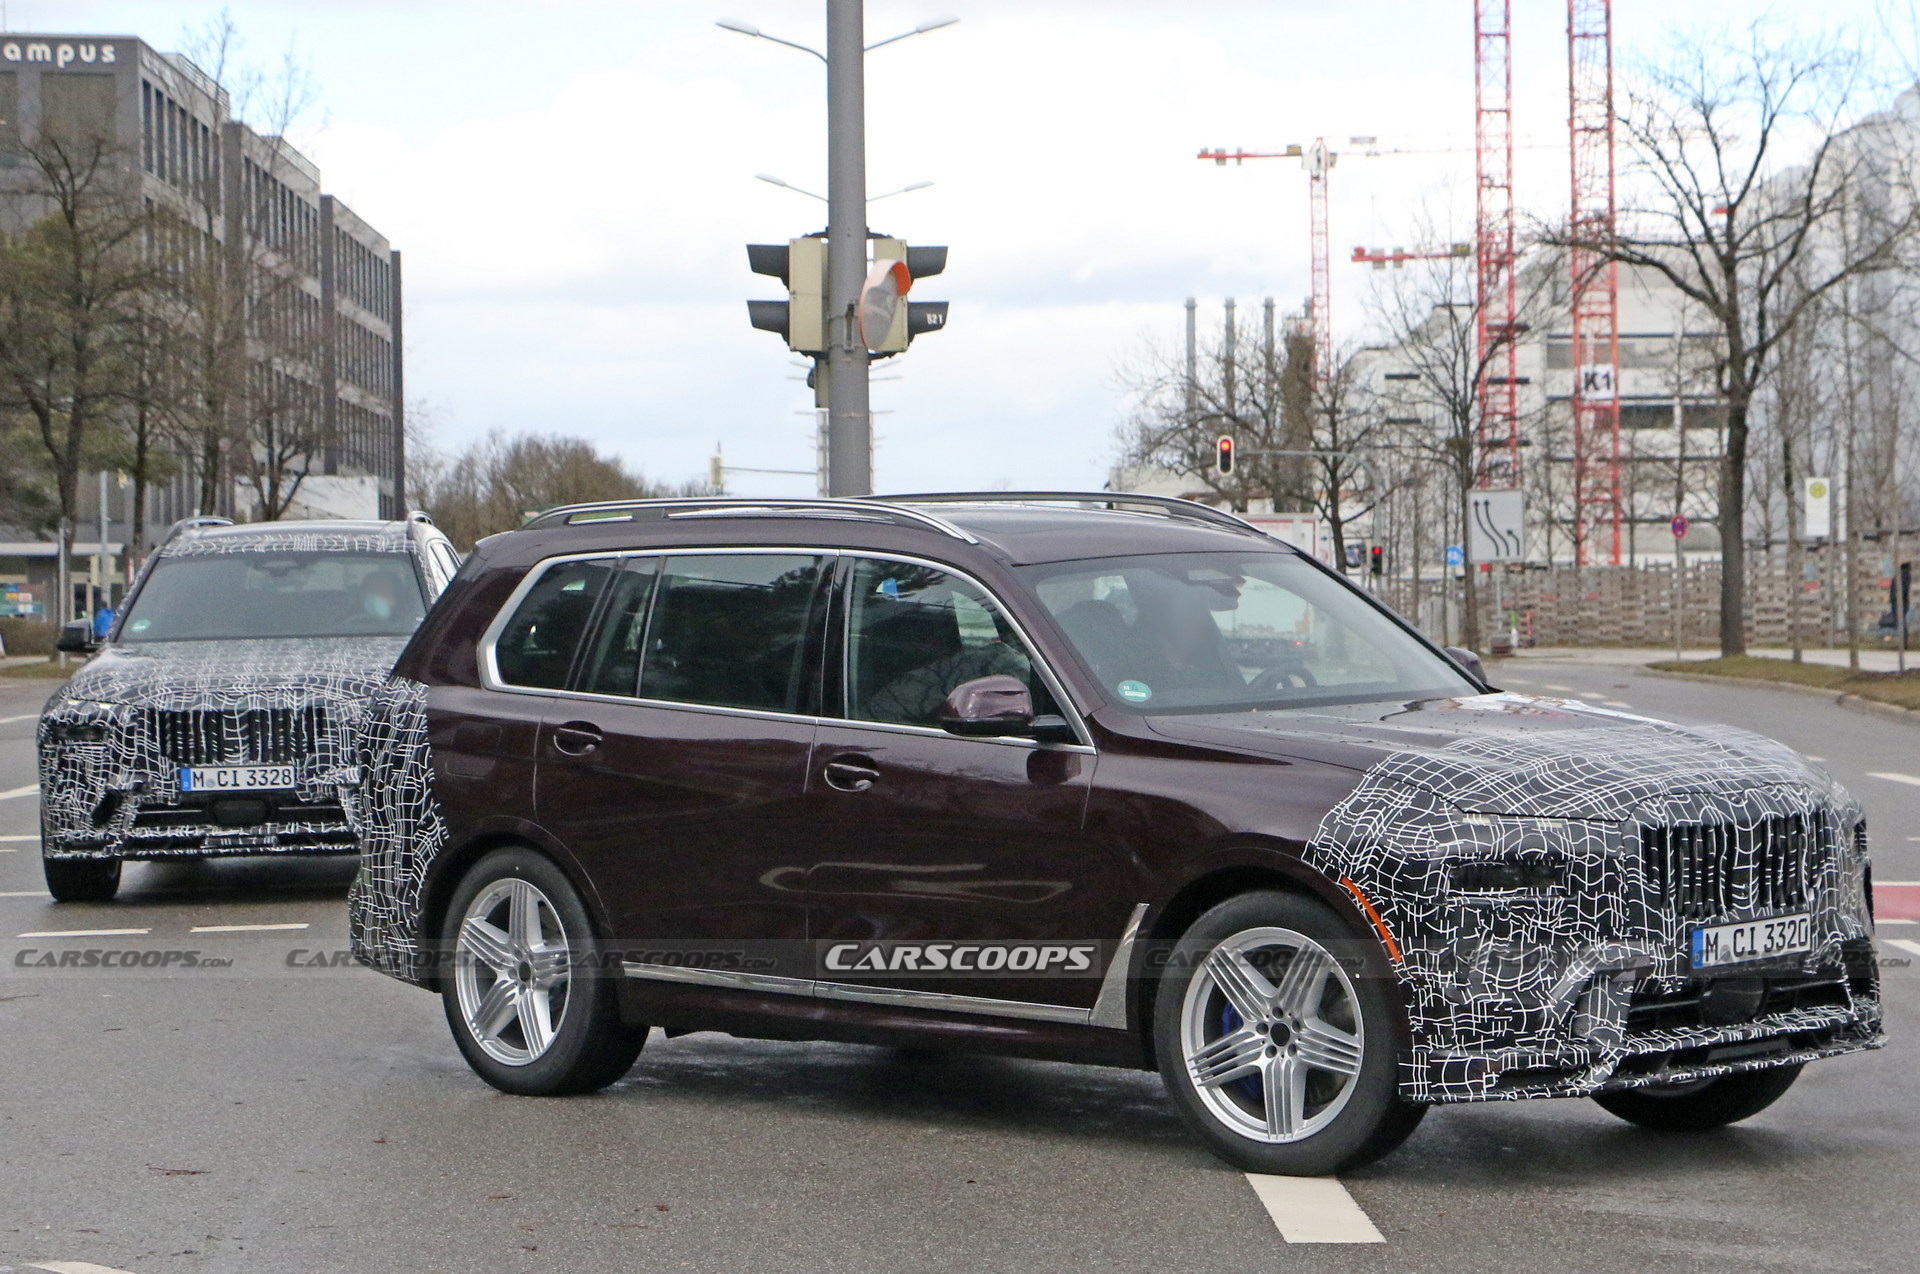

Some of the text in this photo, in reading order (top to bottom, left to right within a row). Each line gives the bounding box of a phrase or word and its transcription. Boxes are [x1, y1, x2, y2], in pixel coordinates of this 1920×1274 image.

[1584, 371, 1610, 391] K1
[192, 771, 204, 788] M
[217, 770, 240, 787] CI
[246, 768, 292, 787] 3328
[1705, 932, 1719, 962] M
[1733, 926, 1758, 957] CI
[1764, 917, 1809, 953] 3320
